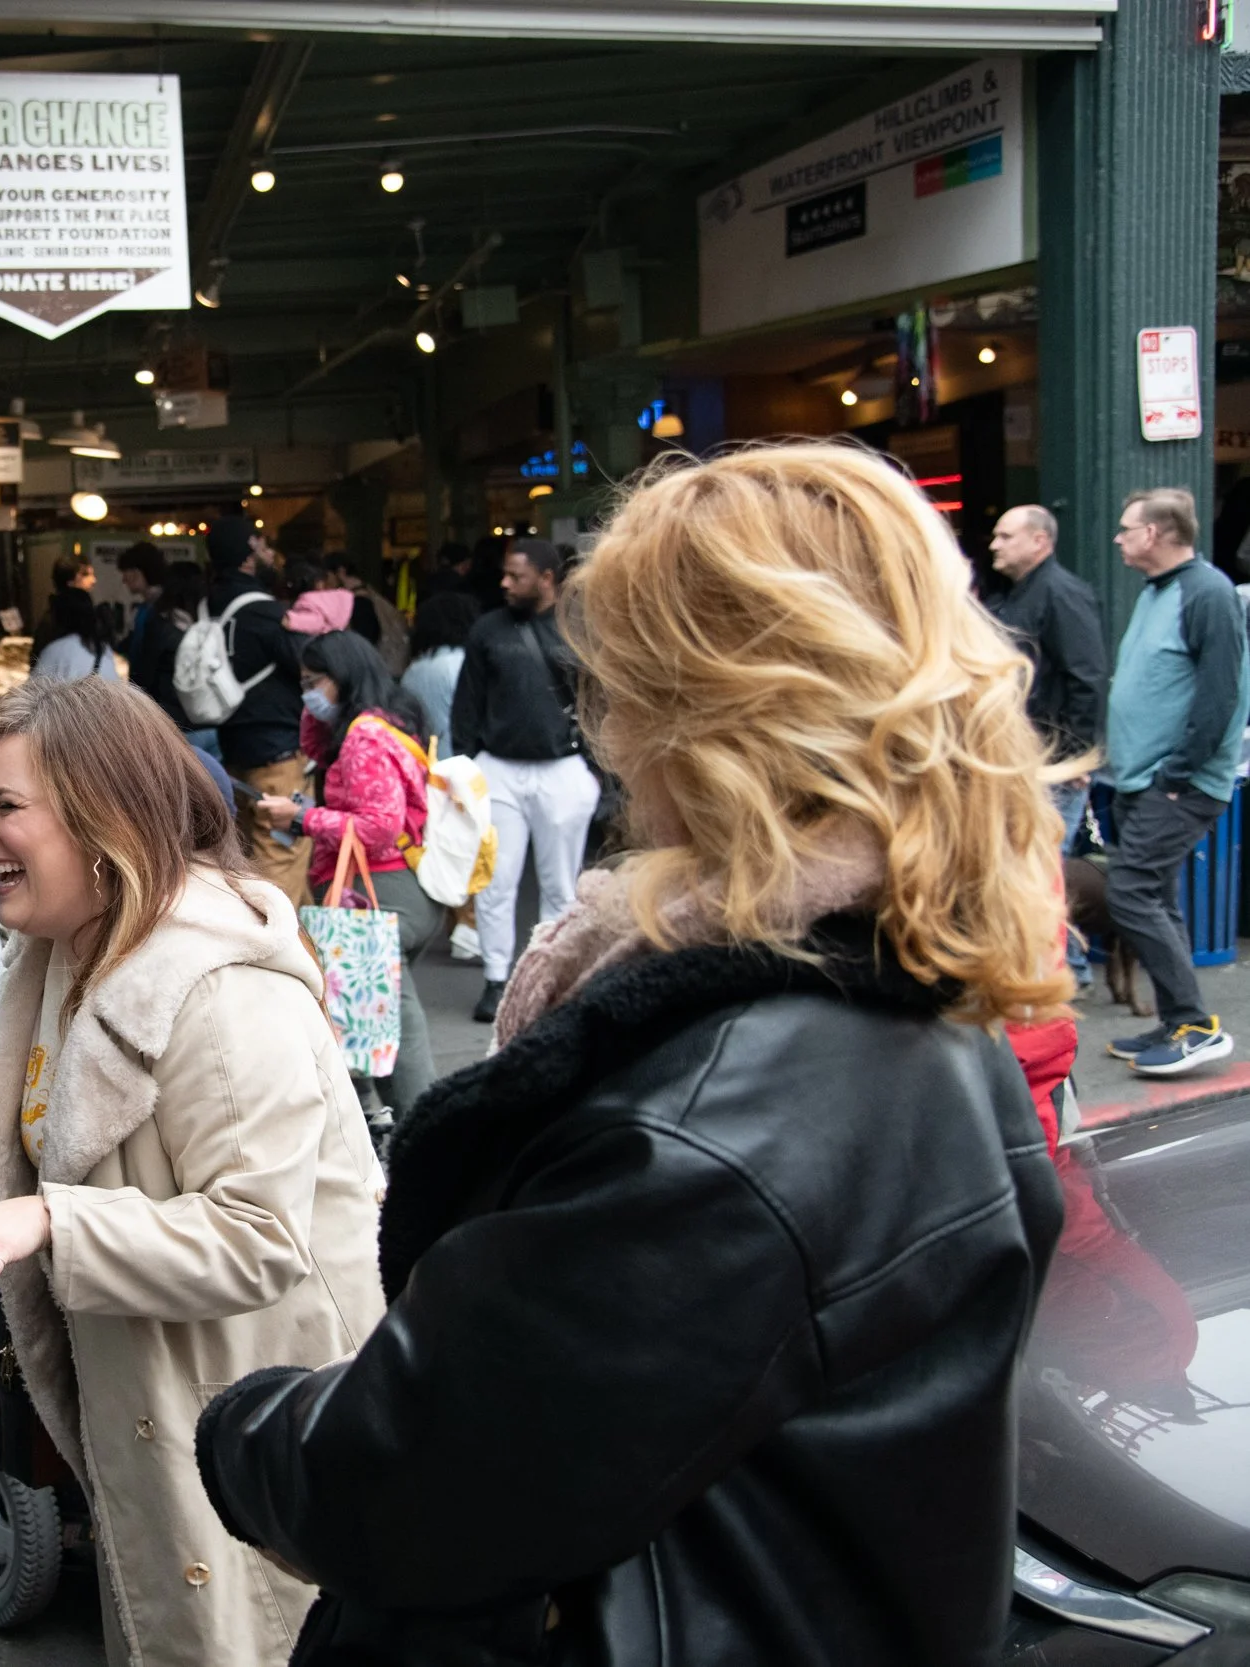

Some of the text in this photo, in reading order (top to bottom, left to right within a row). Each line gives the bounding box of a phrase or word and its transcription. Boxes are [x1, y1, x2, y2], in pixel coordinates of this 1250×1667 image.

[873, 69, 998, 134] HILLCLIMB &
[22, 98, 170, 149] CHANGE
[769, 140, 885, 197] WATERFRONT
[893, 99, 999, 153] VIEWPOINT
[91, 154, 171, 172] LIVES!
[51, 188, 171, 202] GENEROSITY
[64, 208, 91, 223] THE
[95, 208, 125, 223] PIKE
[129, 208, 171, 223] PLACE
[57, 227, 171, 241] FOUNDATION
[69, 271, 136, 292] HERE!
